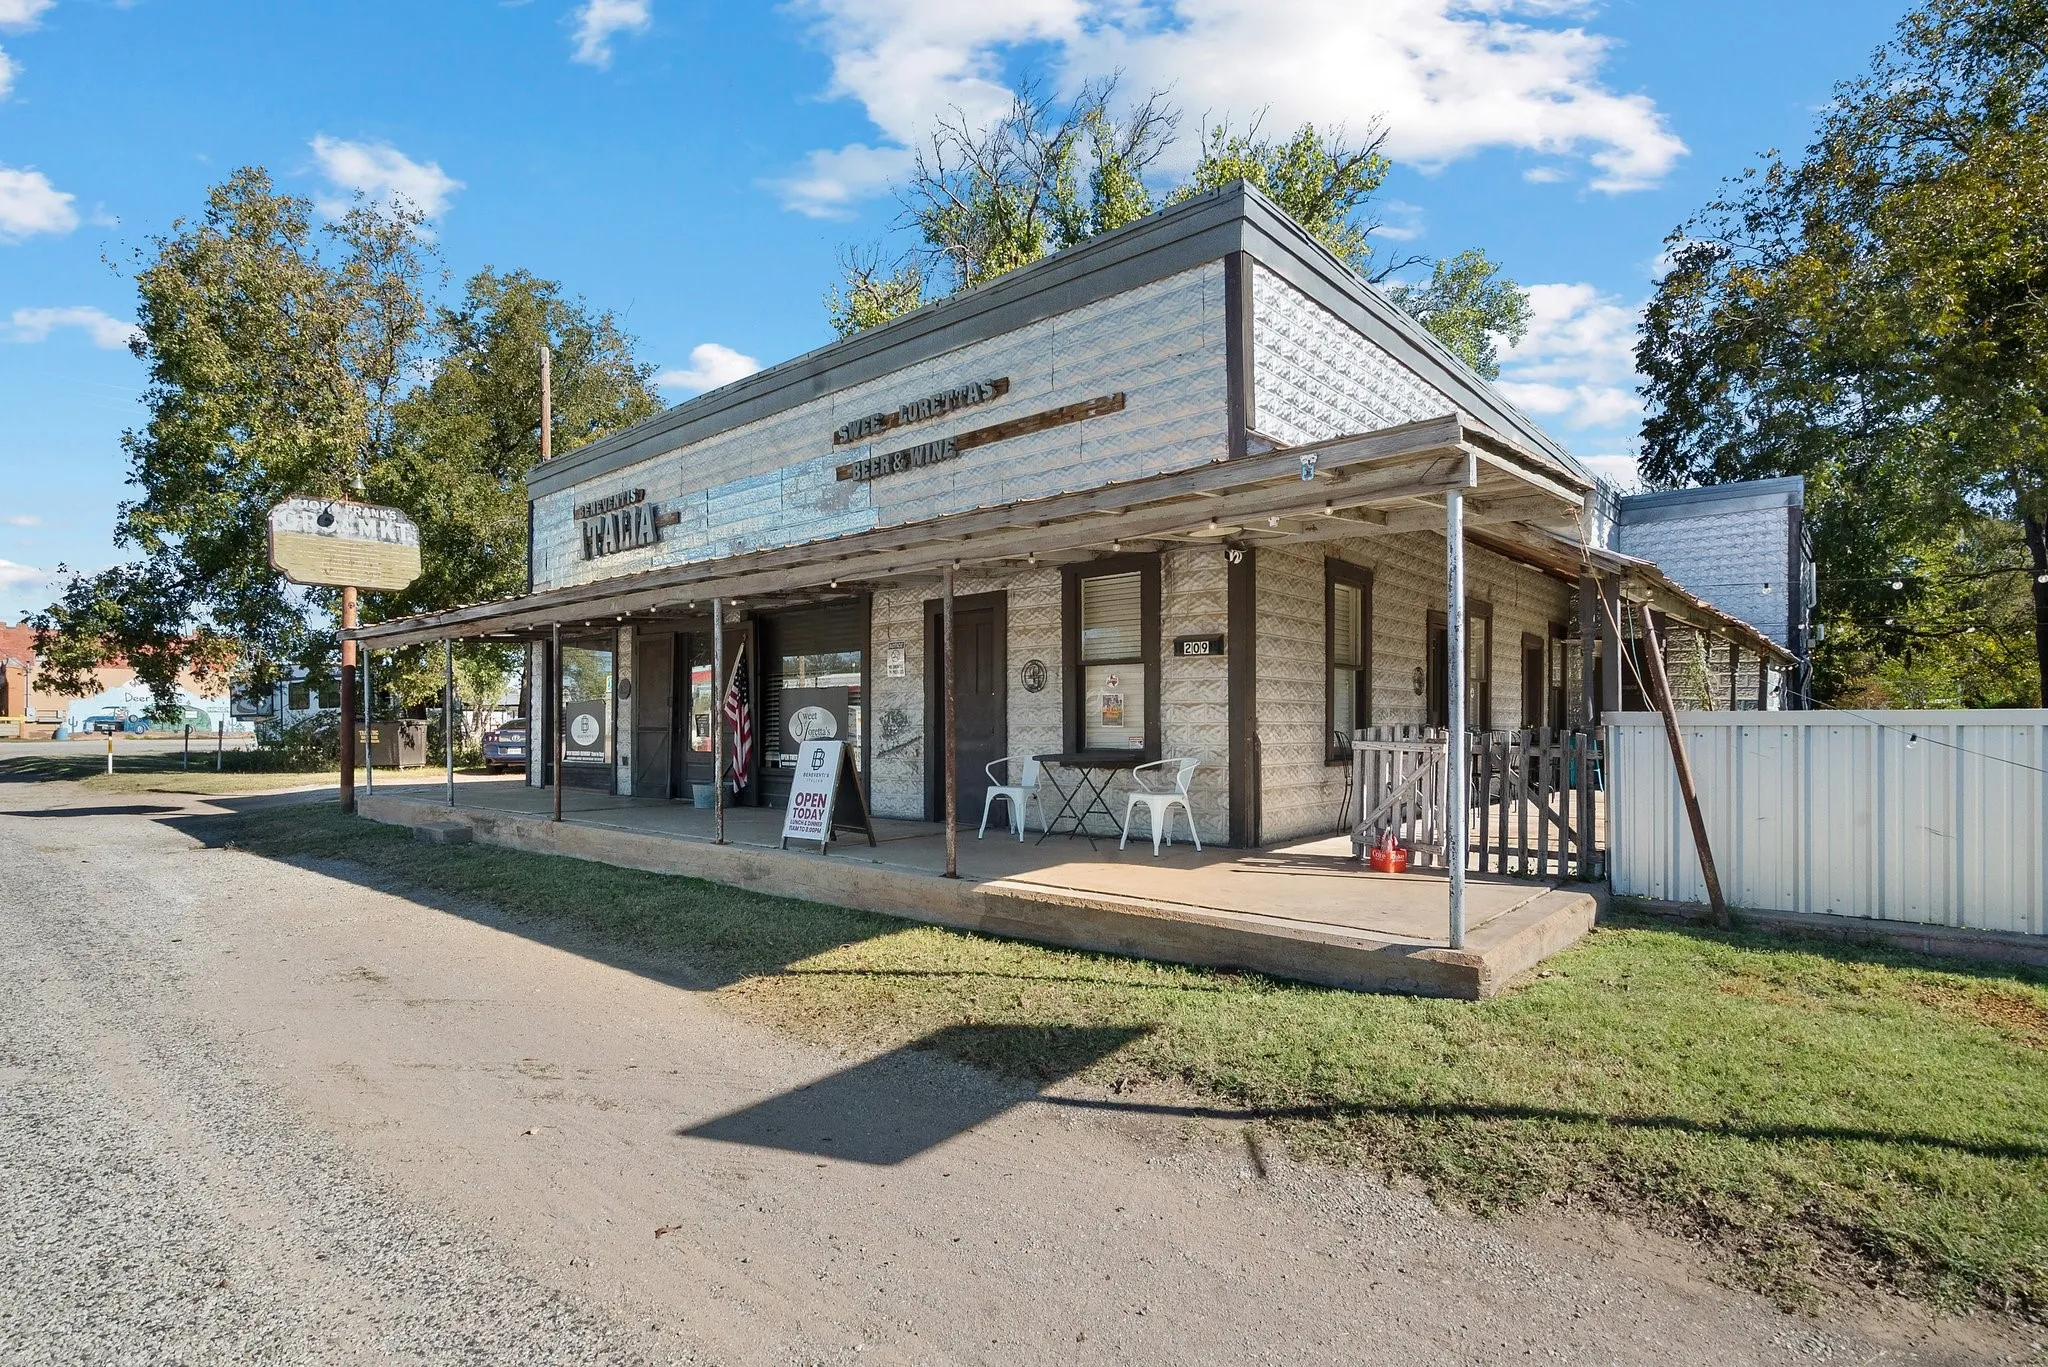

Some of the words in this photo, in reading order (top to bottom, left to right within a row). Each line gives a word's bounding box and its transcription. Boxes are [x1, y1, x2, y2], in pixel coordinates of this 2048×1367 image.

[899, 378, 995, 424] LORETTAS
[852, 455, 890, 482] BEER
[893, 452, 905, 471] &
[910, 437, 957, 467] WINE
[345, 504, 397, 520] FRANK'S
[1185, 642, 1208, 654] 209
[795, 711, 818, 736] Sweet
[795, 792, 828, 808] OPEN
[792, 807, 825, 820] TODAY
